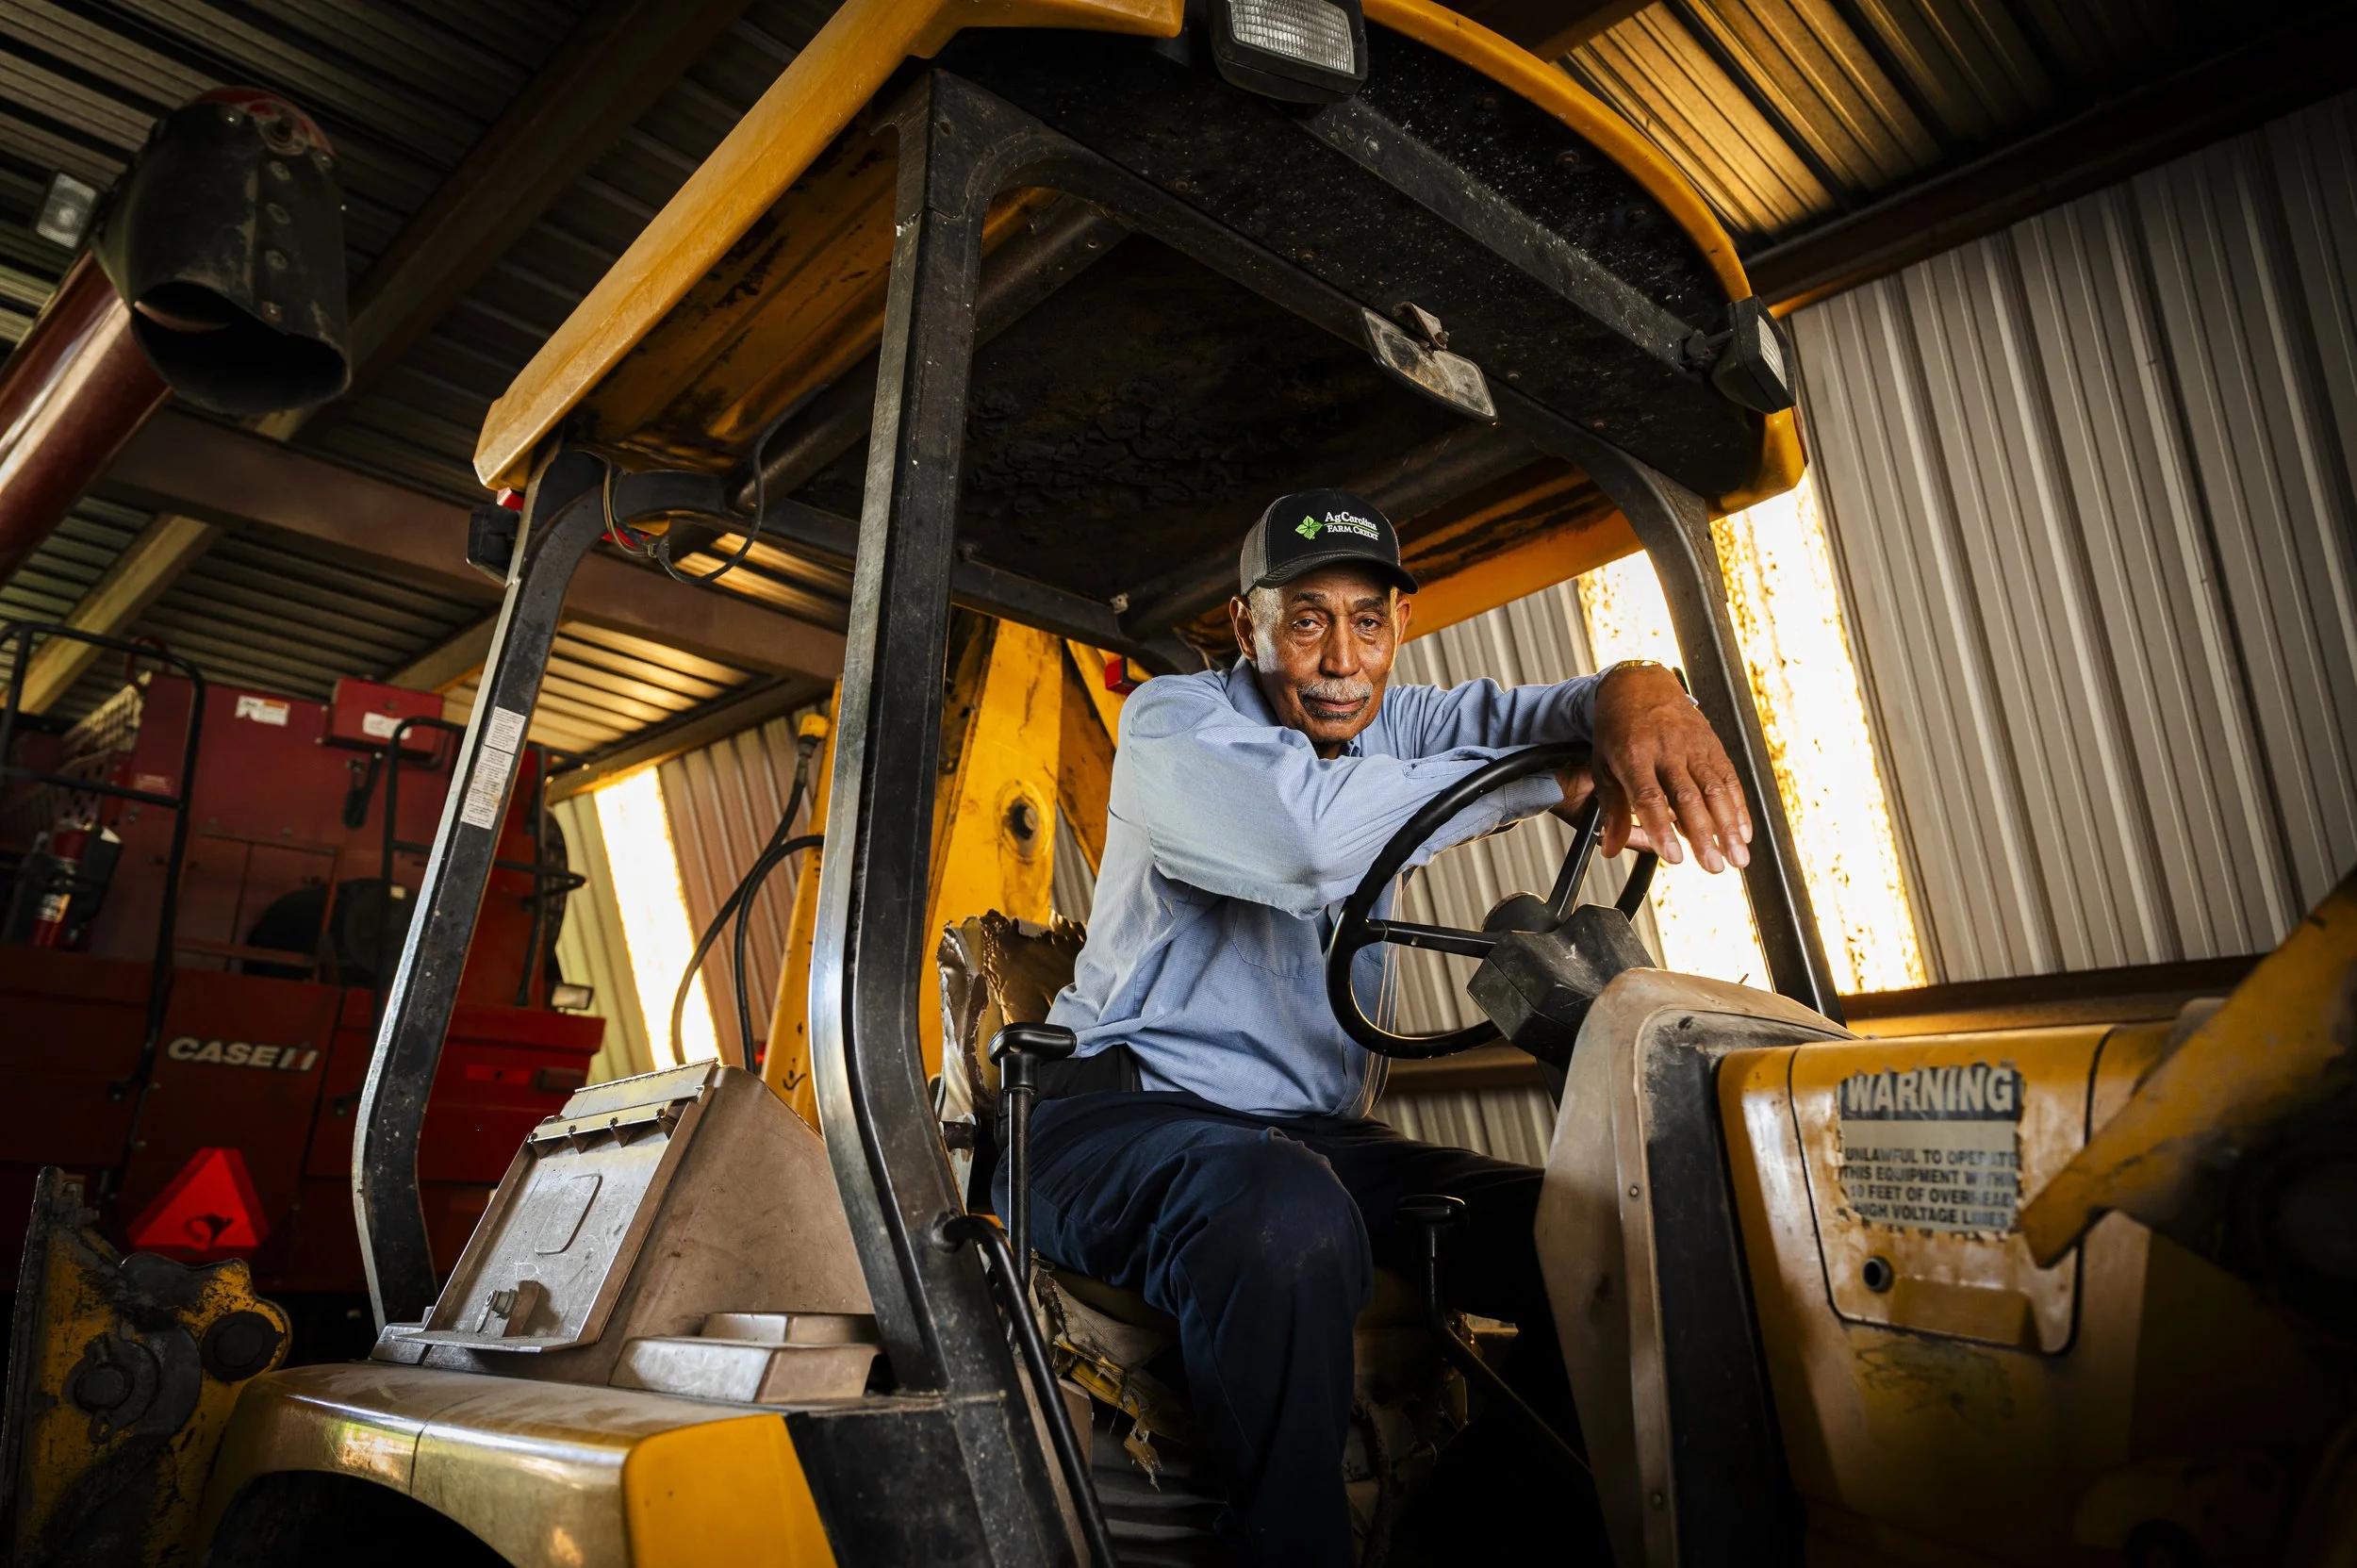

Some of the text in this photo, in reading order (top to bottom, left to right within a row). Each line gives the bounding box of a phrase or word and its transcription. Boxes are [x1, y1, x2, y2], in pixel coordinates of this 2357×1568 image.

[1327, 524, 1353, 533] FARM
[168, 1037, 279, 1067] CASE
[1848, 1067, 2013, 1113] WARNING
[1845, 1147, 1918, 1164] UNLAWFUL
[1922, 1148, 1942, 1164] TO
[1841, 1164, 2017, 1187] THIS EQUIPMENT WTHIN
[1868, 1184, 1902, 1200] FEET
[1905, 1186, 1924, 1202] OF
[1892, 1204, 1958, 1224] VOLTAGE
[1962, 1210, 2008, 1227] LNES
